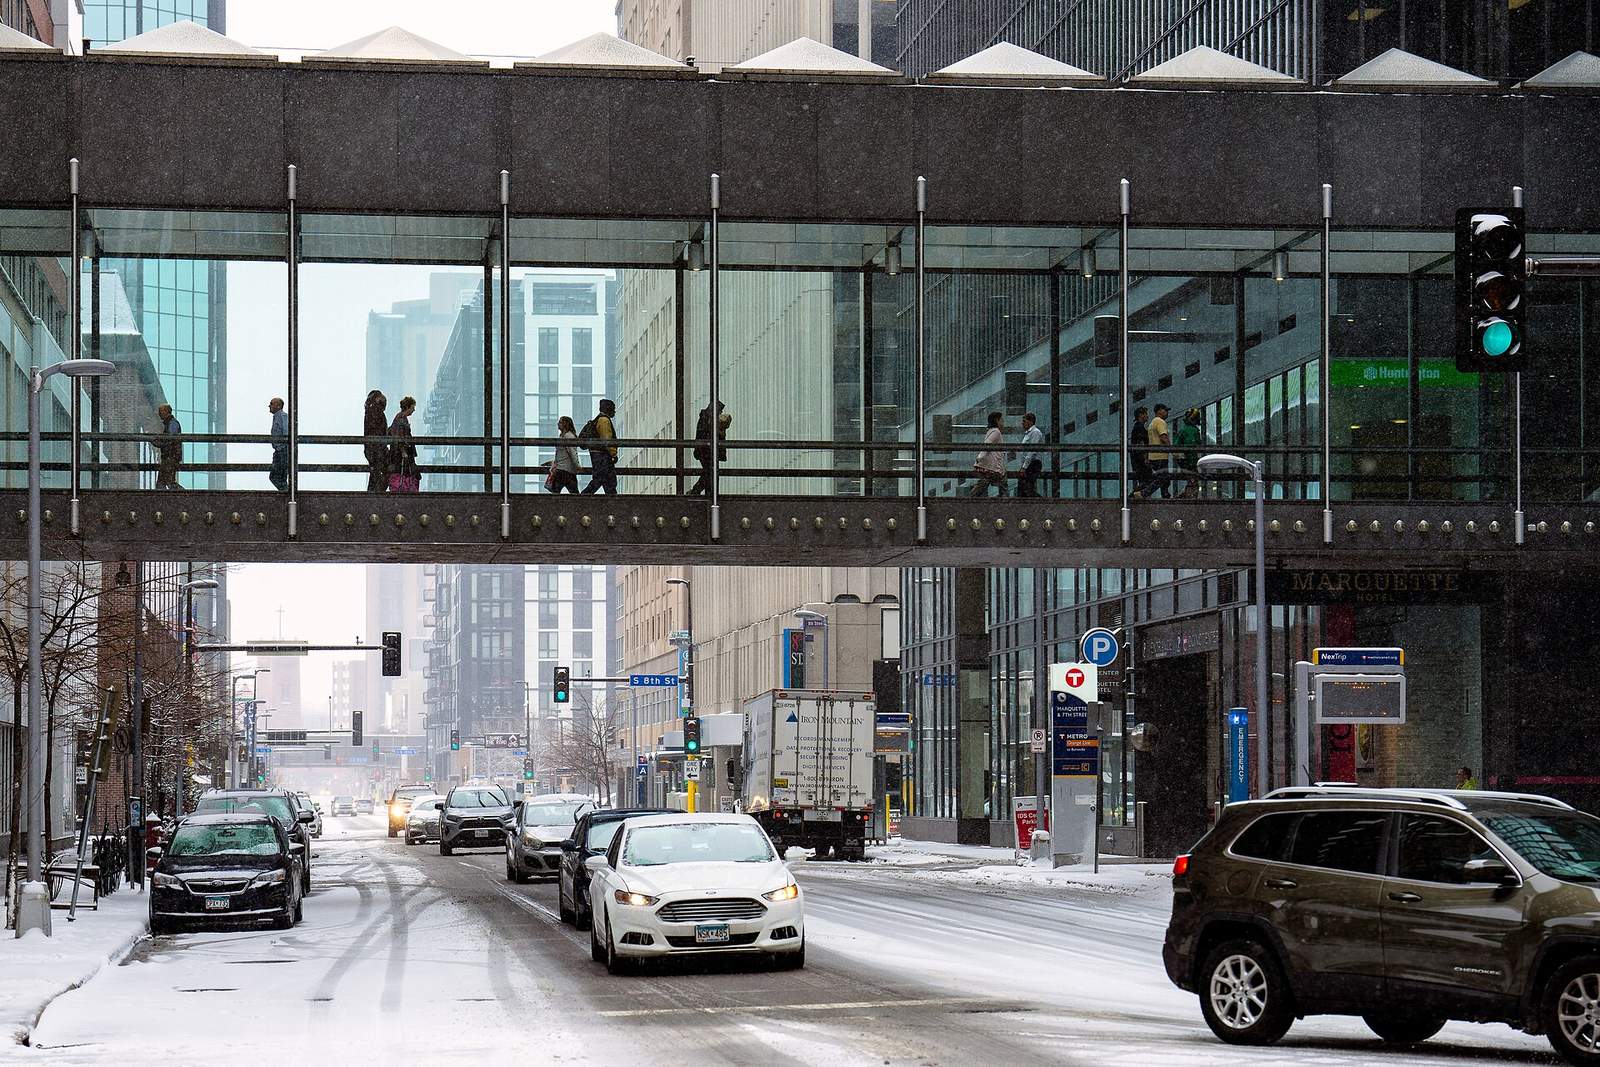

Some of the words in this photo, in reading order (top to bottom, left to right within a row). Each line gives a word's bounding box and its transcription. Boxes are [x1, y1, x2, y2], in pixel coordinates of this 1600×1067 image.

[1379, 366, 1440, 381] Huntiton
[1291, 573, 1458, 591] MARQUETTE
[1357, 593, 1394, 601] HOTEL
[1092, 637, 1111, 661] P
[1321, 653, 1347, 661] NexTrip
[633, 677, 639, 685] S
[643, 677, 661, 685] 8th
[664, 677, 675, 685] St
[801, 715, 819, 724] IRON
[820, 715, 863, 725] MOUNTAIN
[1454, 966, 1501, 976] CHEROKEE
